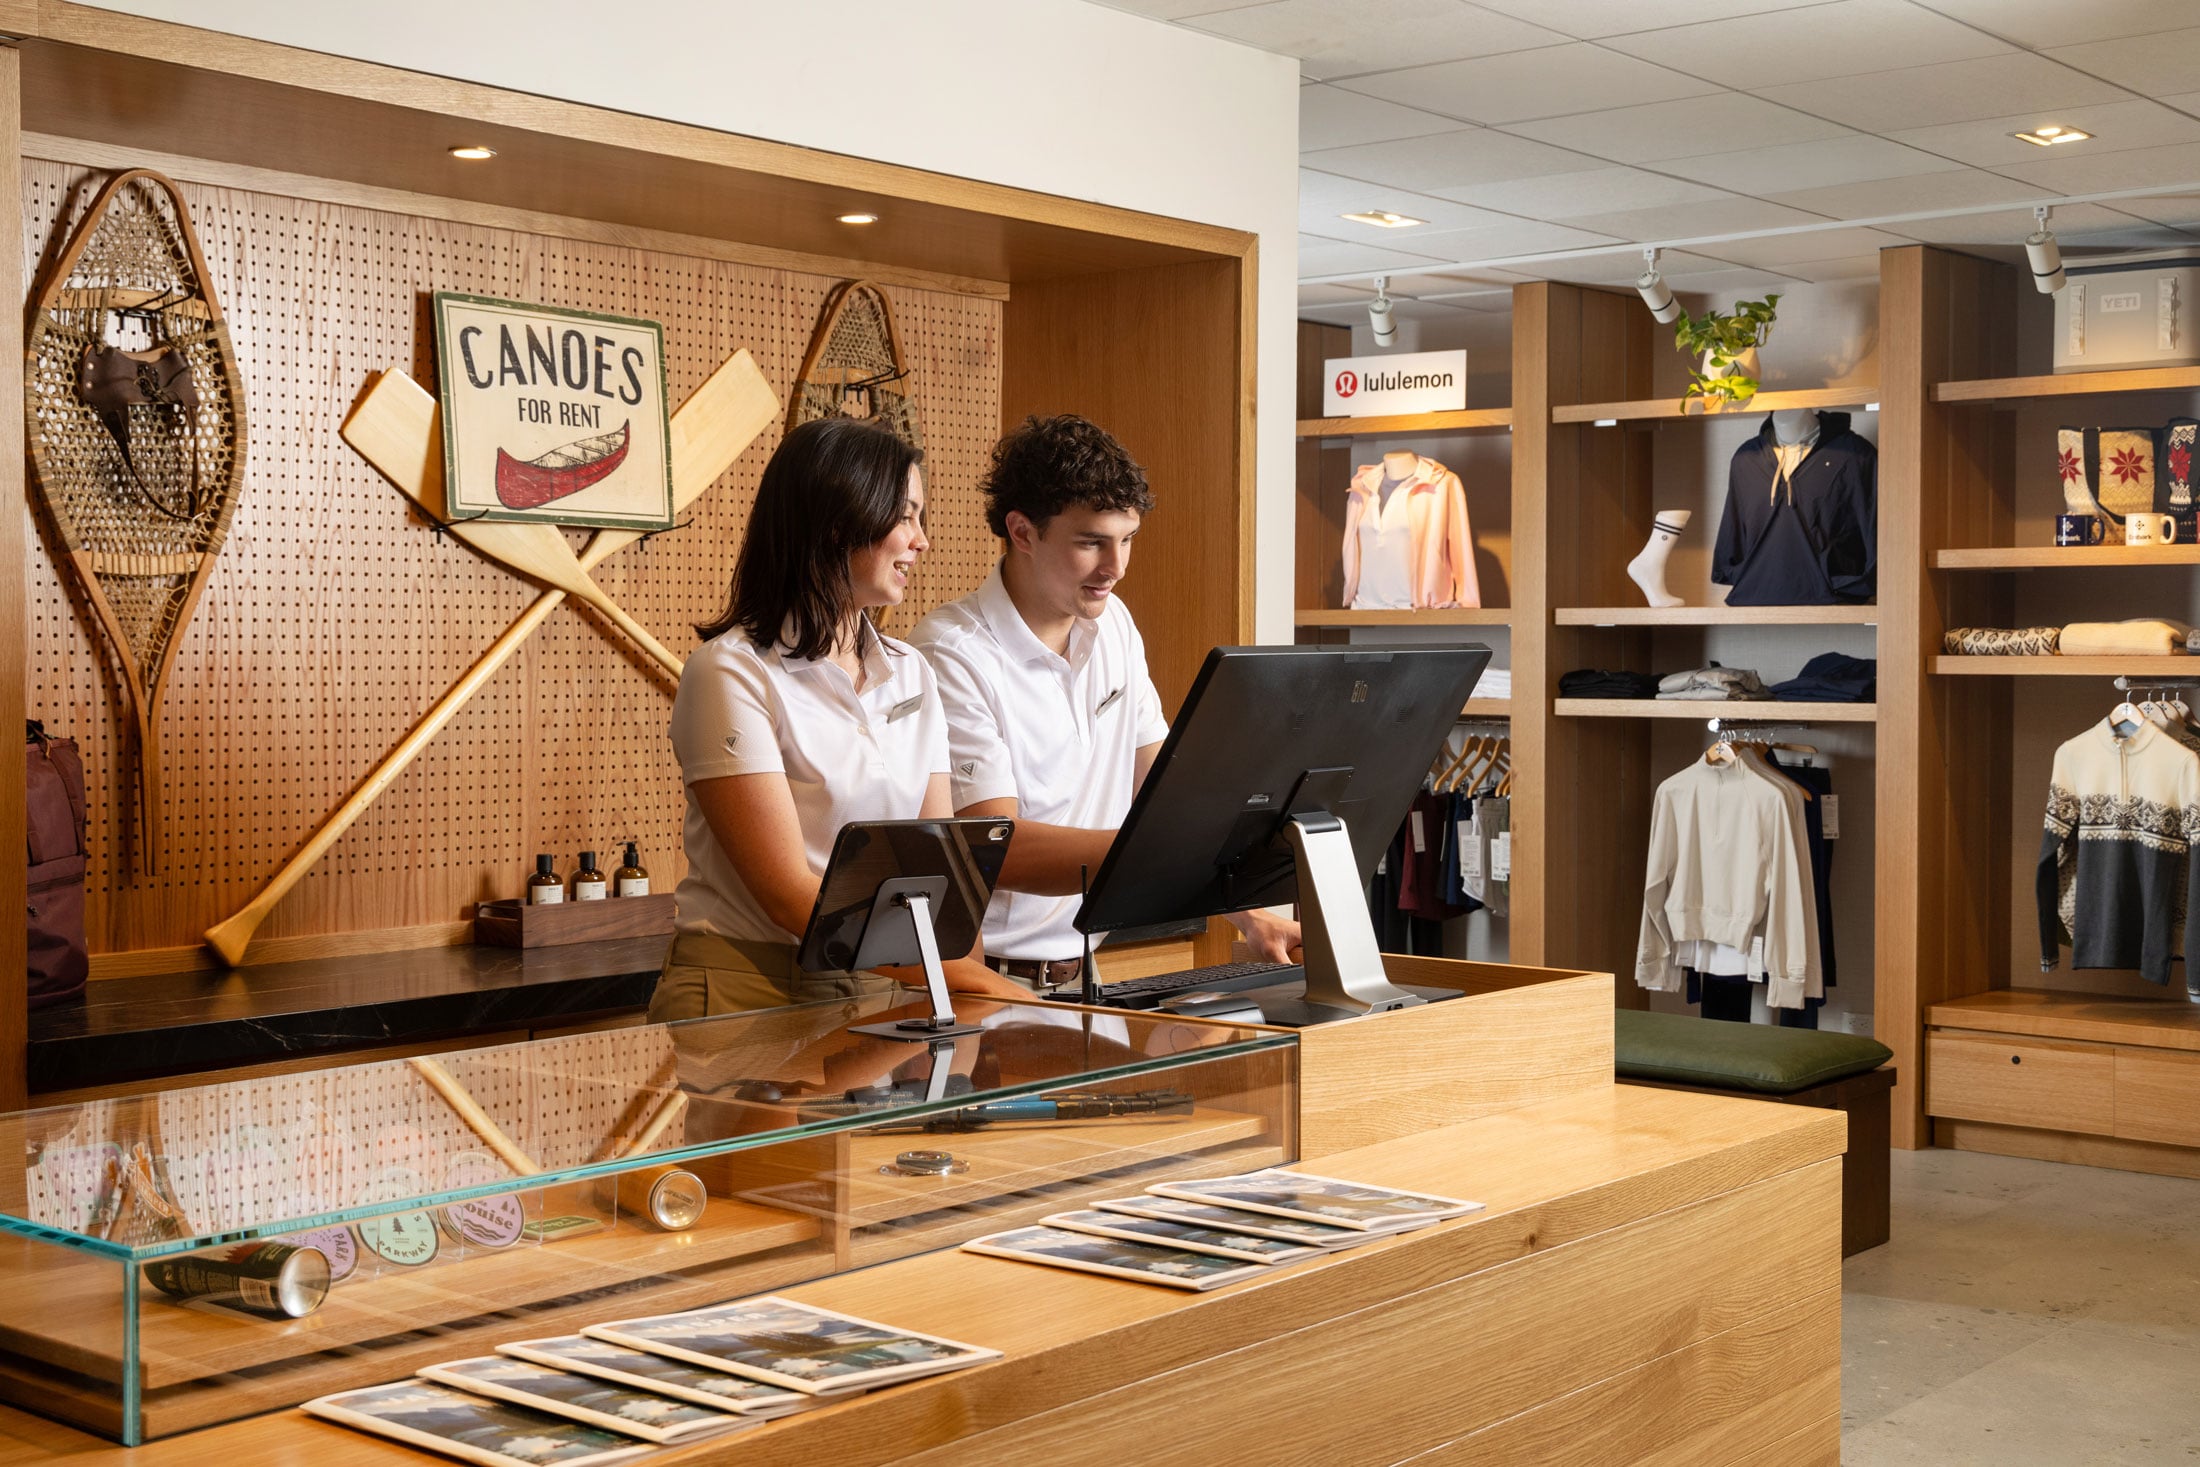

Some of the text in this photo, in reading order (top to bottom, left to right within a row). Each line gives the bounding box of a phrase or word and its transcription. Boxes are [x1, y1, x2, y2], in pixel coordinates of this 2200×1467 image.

[2103, 296, 2137, 309] YETI
[459, 323, 644, 406] CANOES
[1364, 371, 1453, 392] lululemon
[518, 397, 601, 429] FOR RENT
